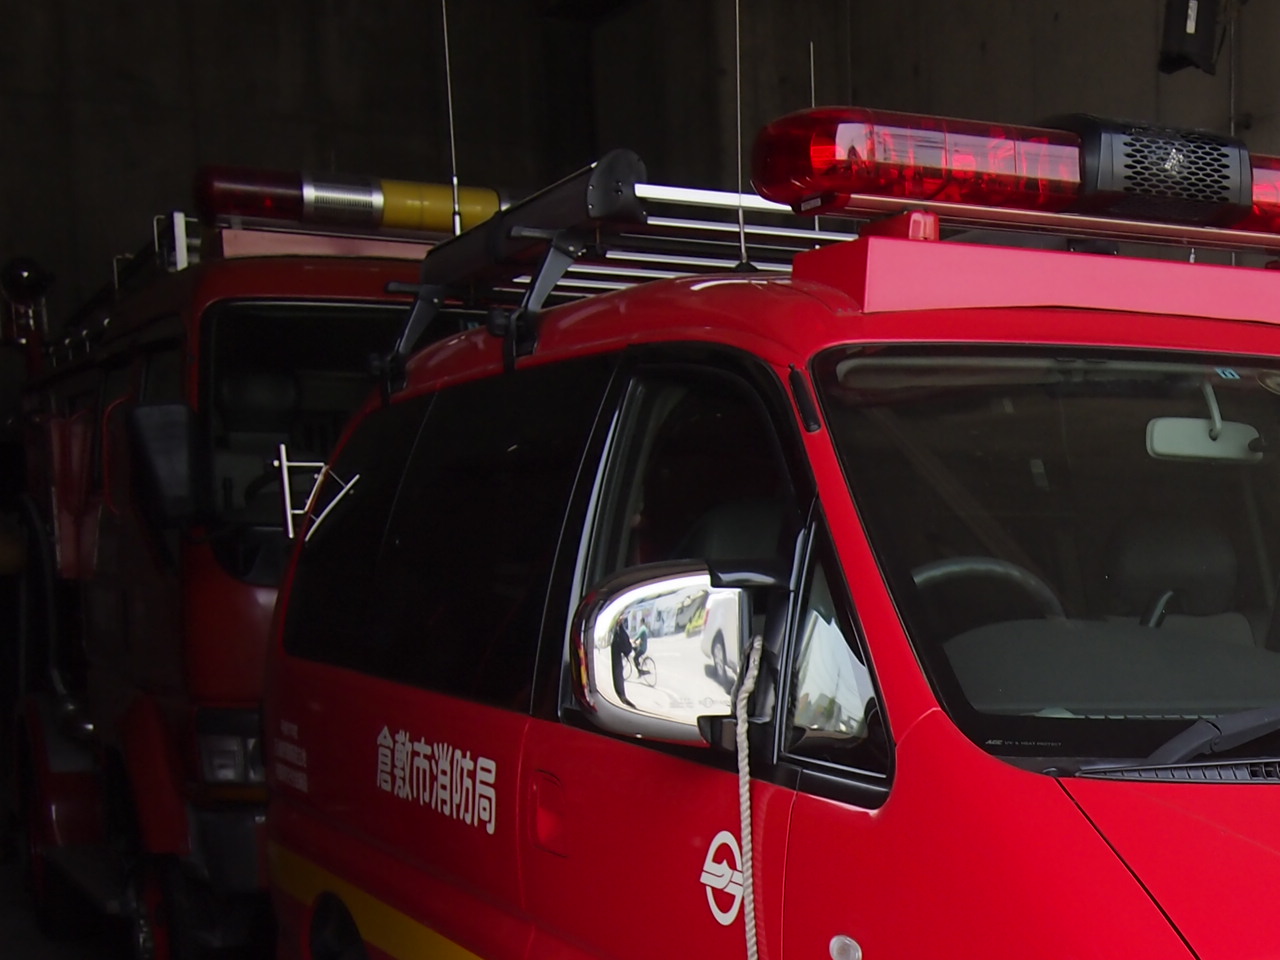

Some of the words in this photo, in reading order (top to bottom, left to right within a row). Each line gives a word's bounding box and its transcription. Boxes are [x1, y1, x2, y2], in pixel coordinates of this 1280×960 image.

[377, 725, 496, 835] 倉敷市消防局
